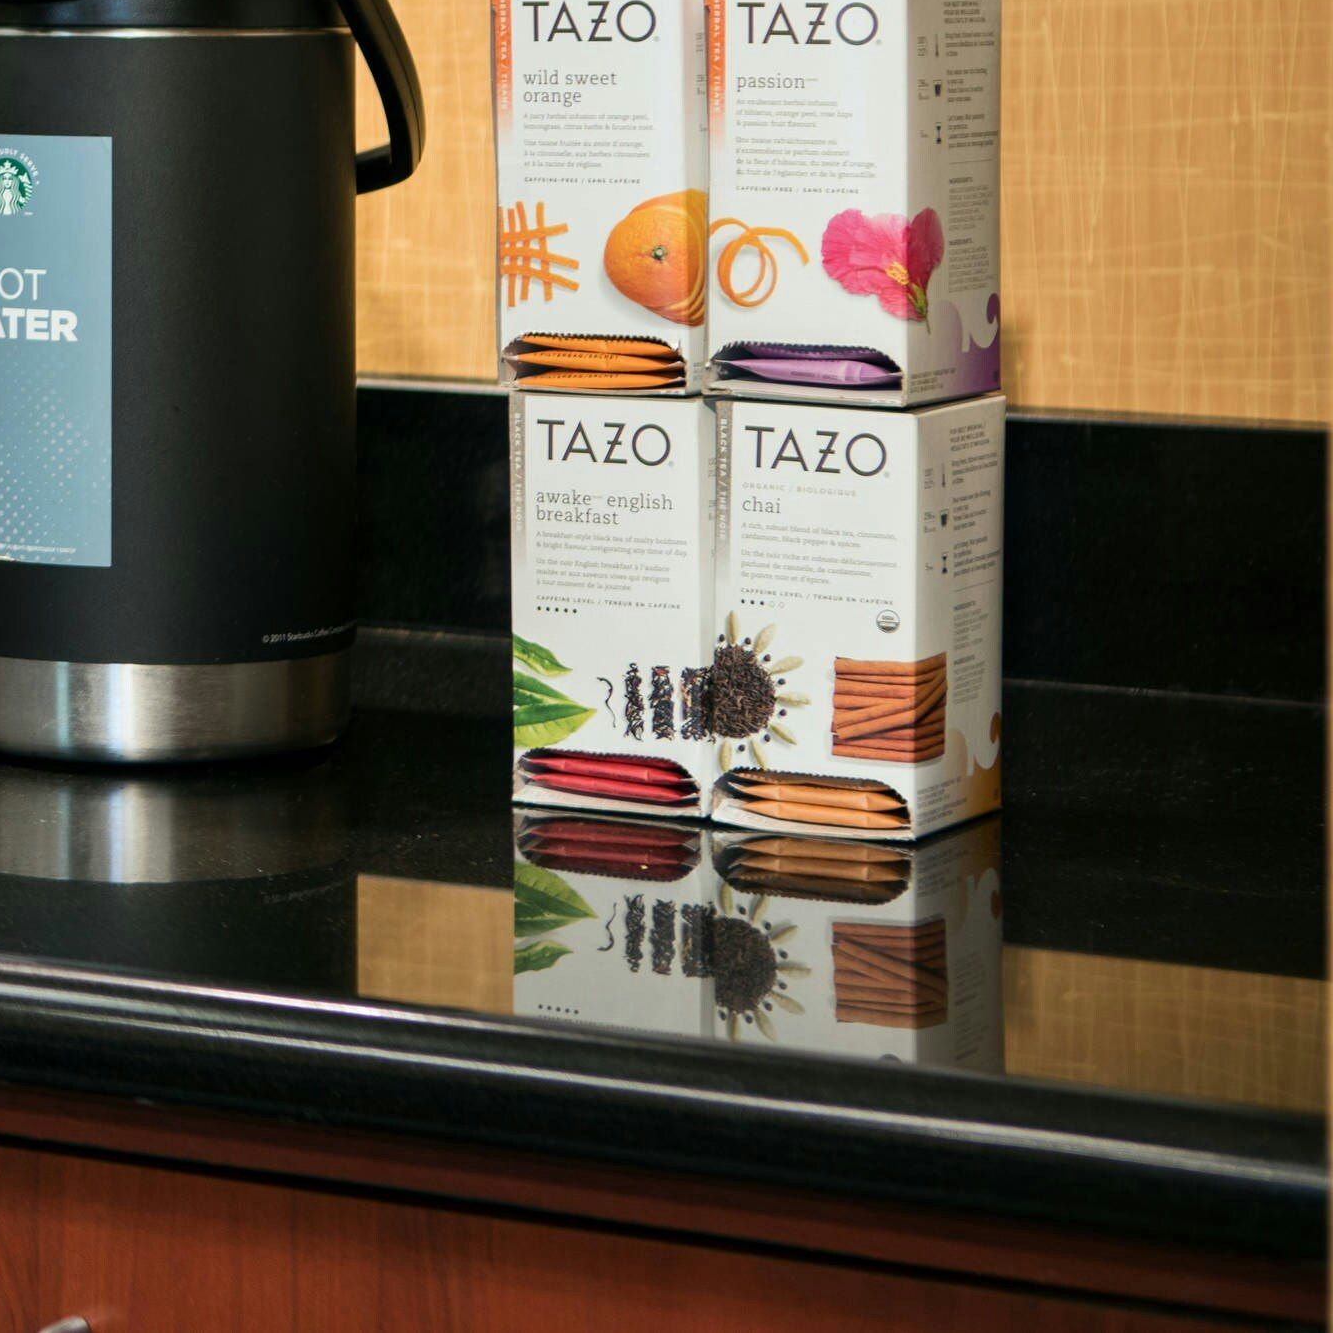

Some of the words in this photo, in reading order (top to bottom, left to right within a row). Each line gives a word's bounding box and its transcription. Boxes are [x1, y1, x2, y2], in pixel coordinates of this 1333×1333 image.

[522, 0, 657, 42] TAZO
[736, 2, 879, 46] TAZO
[499, 41, 510, 60] TEA
[713, 42, 723, 61] TEA
[523, 69, 559, 85] wild
[565, 71, 618, 86] sweet
[736, 72, 806, 92] passion
[523, 90, 582, 107] orange
[515, 413, 523, 445] BLACK
[720, 418, 729, 452] BLACK
[536, 418, 671, 466] TAZO
[744, 425, 887, 477] TAZO
[515, 451, 523, 470] TEA
[719, 457, 728, 476] TEA
[742, 482, 786, 492] ORGANIC
[536, 489, 592, 505] awake
[606, 492, 674, 513] english
[742, 496, 781, 514] chai
[536, 504, 620, 525] breakfast
[779, 590, 803, 599] LEVEL
[270, 633, 286, 642] 2011
